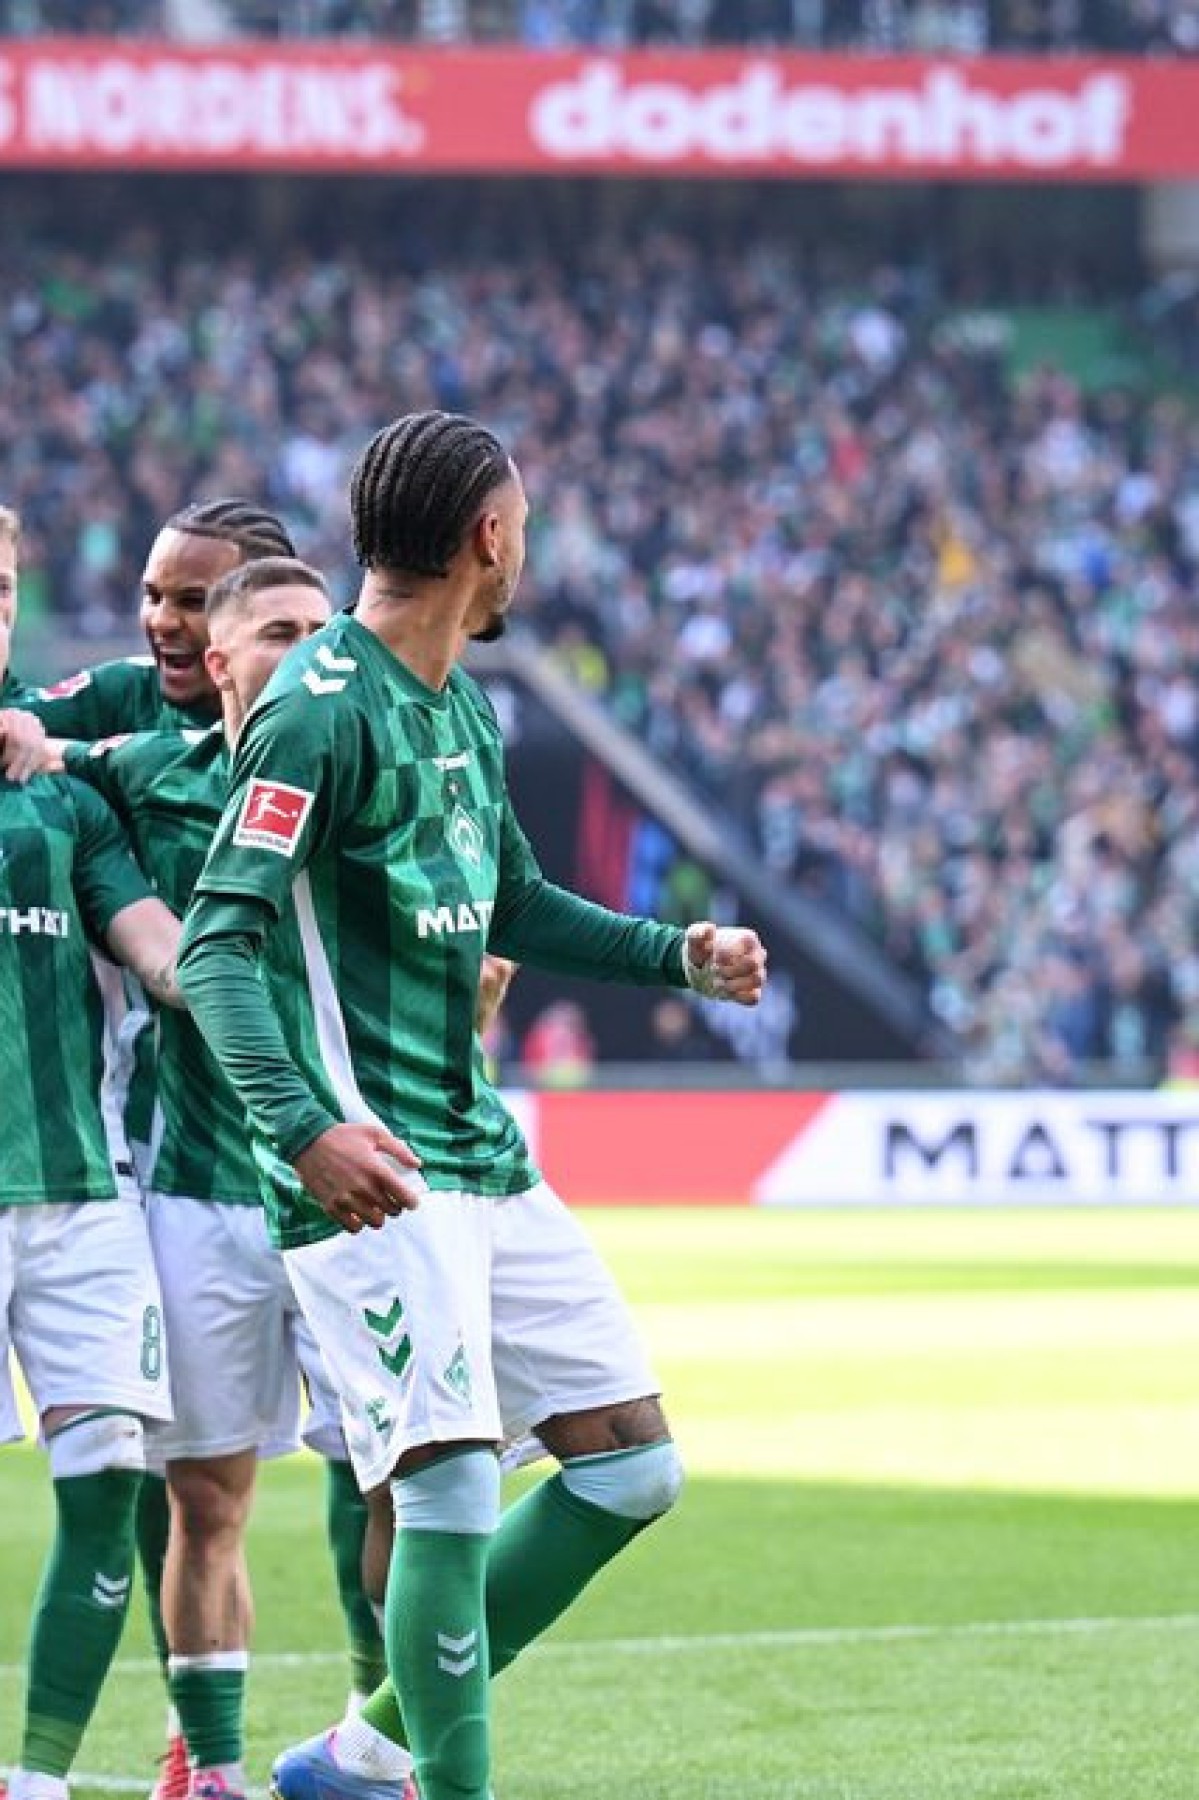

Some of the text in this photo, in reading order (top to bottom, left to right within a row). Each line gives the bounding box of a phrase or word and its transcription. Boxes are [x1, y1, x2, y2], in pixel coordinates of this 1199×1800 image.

[530, 63, 1128, 164] dodenhof
[885, 1120, 1199, 1178] MATT
[141, 1305, 160, 1381] 8
